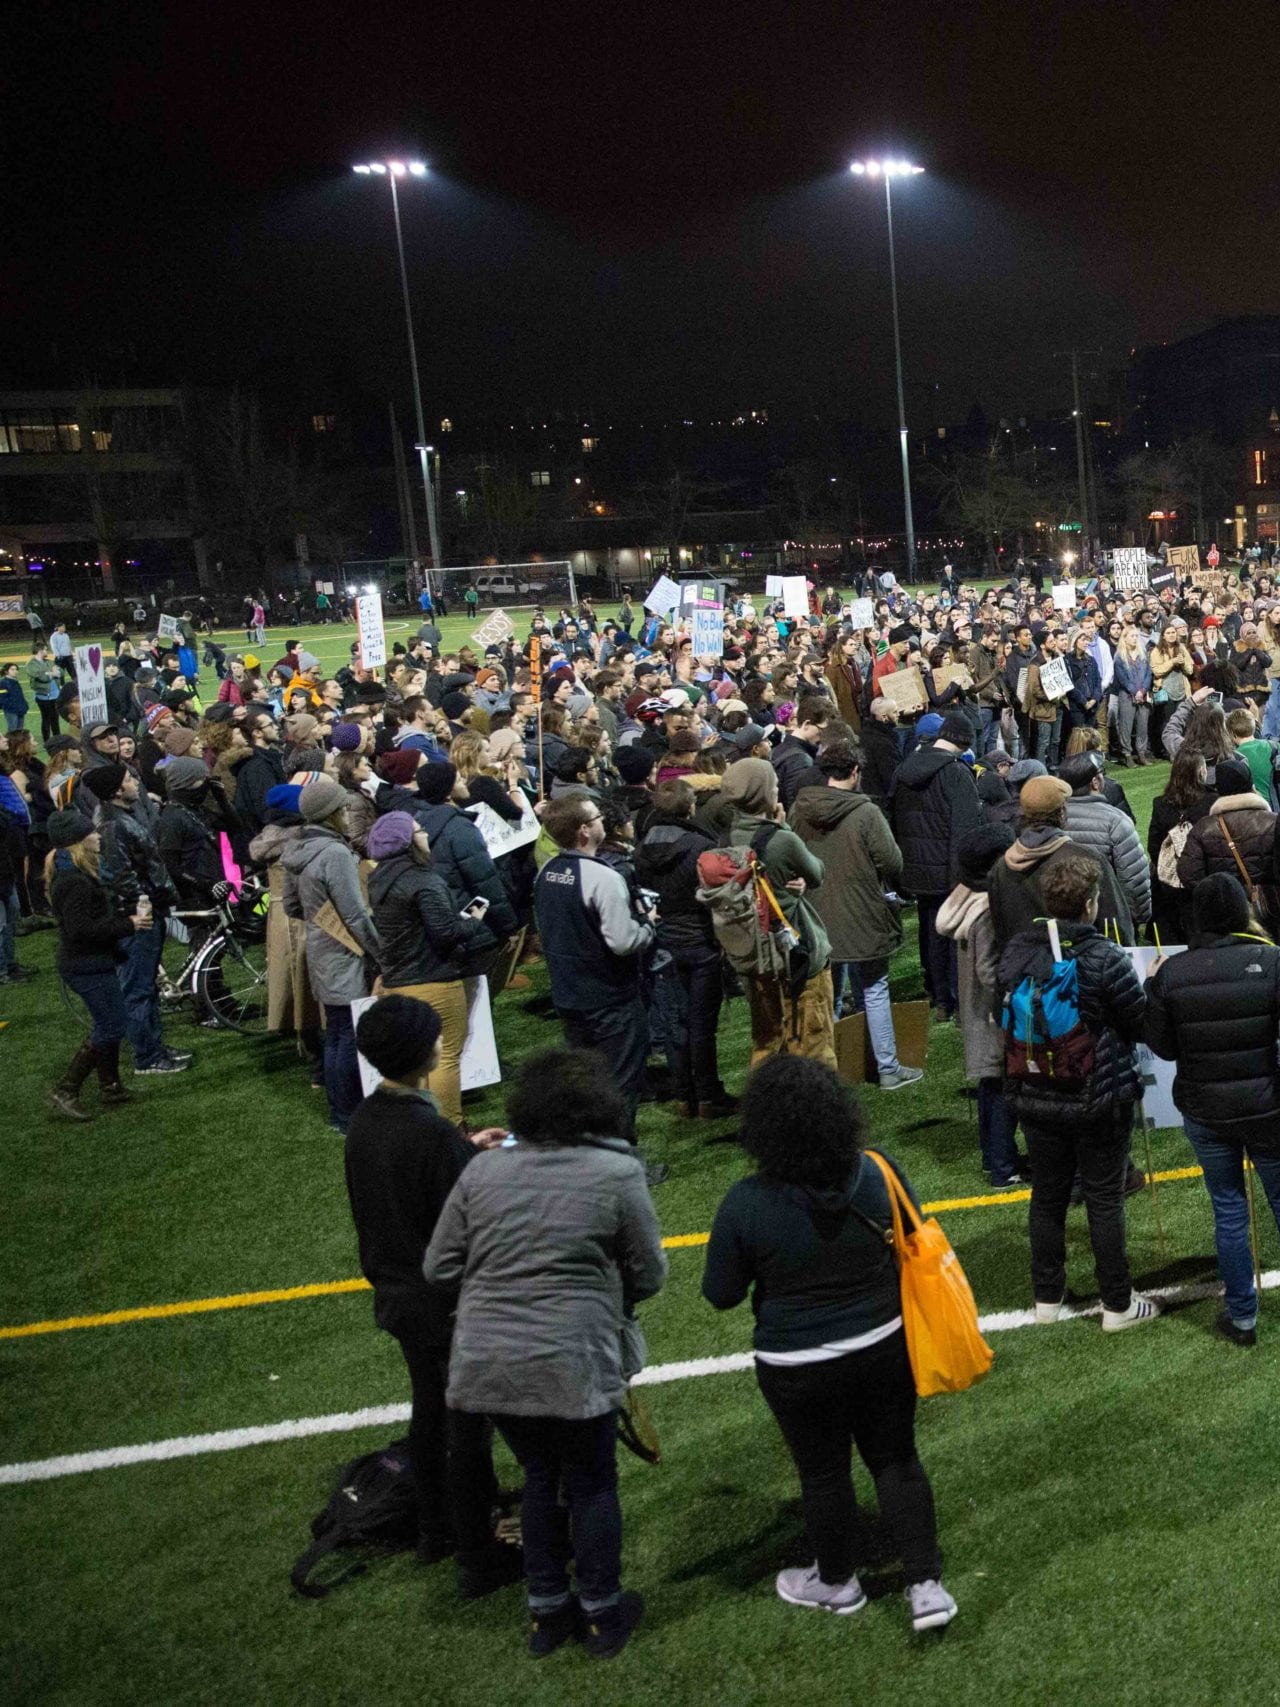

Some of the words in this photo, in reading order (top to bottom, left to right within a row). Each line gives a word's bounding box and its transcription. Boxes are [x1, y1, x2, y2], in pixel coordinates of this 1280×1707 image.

[1113, 548, 1146, 562] PEOPLE
[1115, 562, 1131, 576] ARE
[1133, 561, 1147, 576] NOT
[1115, 576, 1148, 589] ILLEGAL
[472, 612, 512, 650] RESIST
[81, 686, 103, 702] MUSLIM
